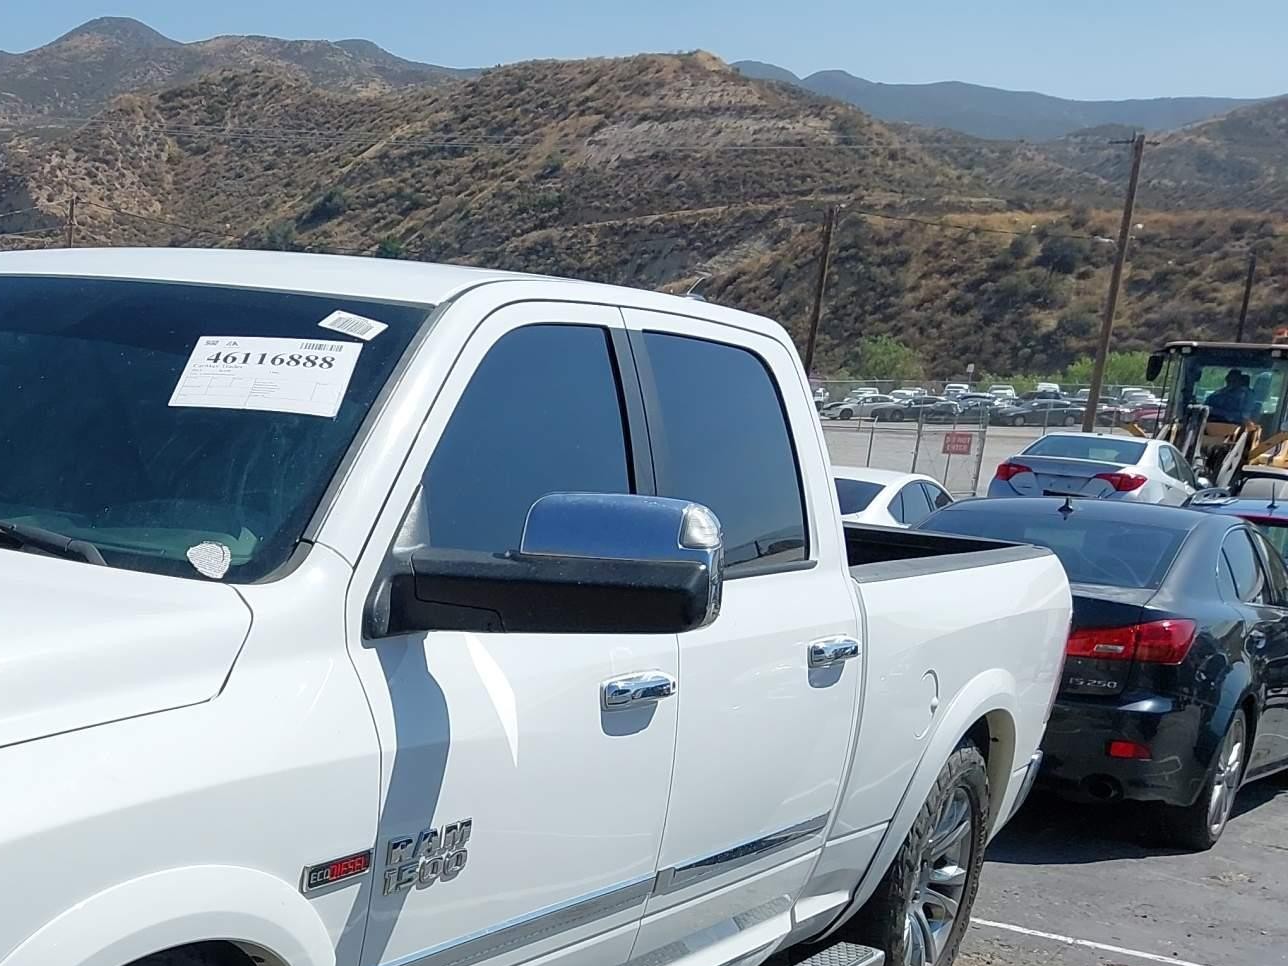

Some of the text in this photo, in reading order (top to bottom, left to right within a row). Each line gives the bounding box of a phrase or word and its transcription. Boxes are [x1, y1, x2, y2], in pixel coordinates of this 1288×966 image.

[207, 352, 336, 370] 46116888
[1086, 679, 1118, 689] 250
[386, 818, 473, 866] RAM
[382, 848, 468, 897] 1500
